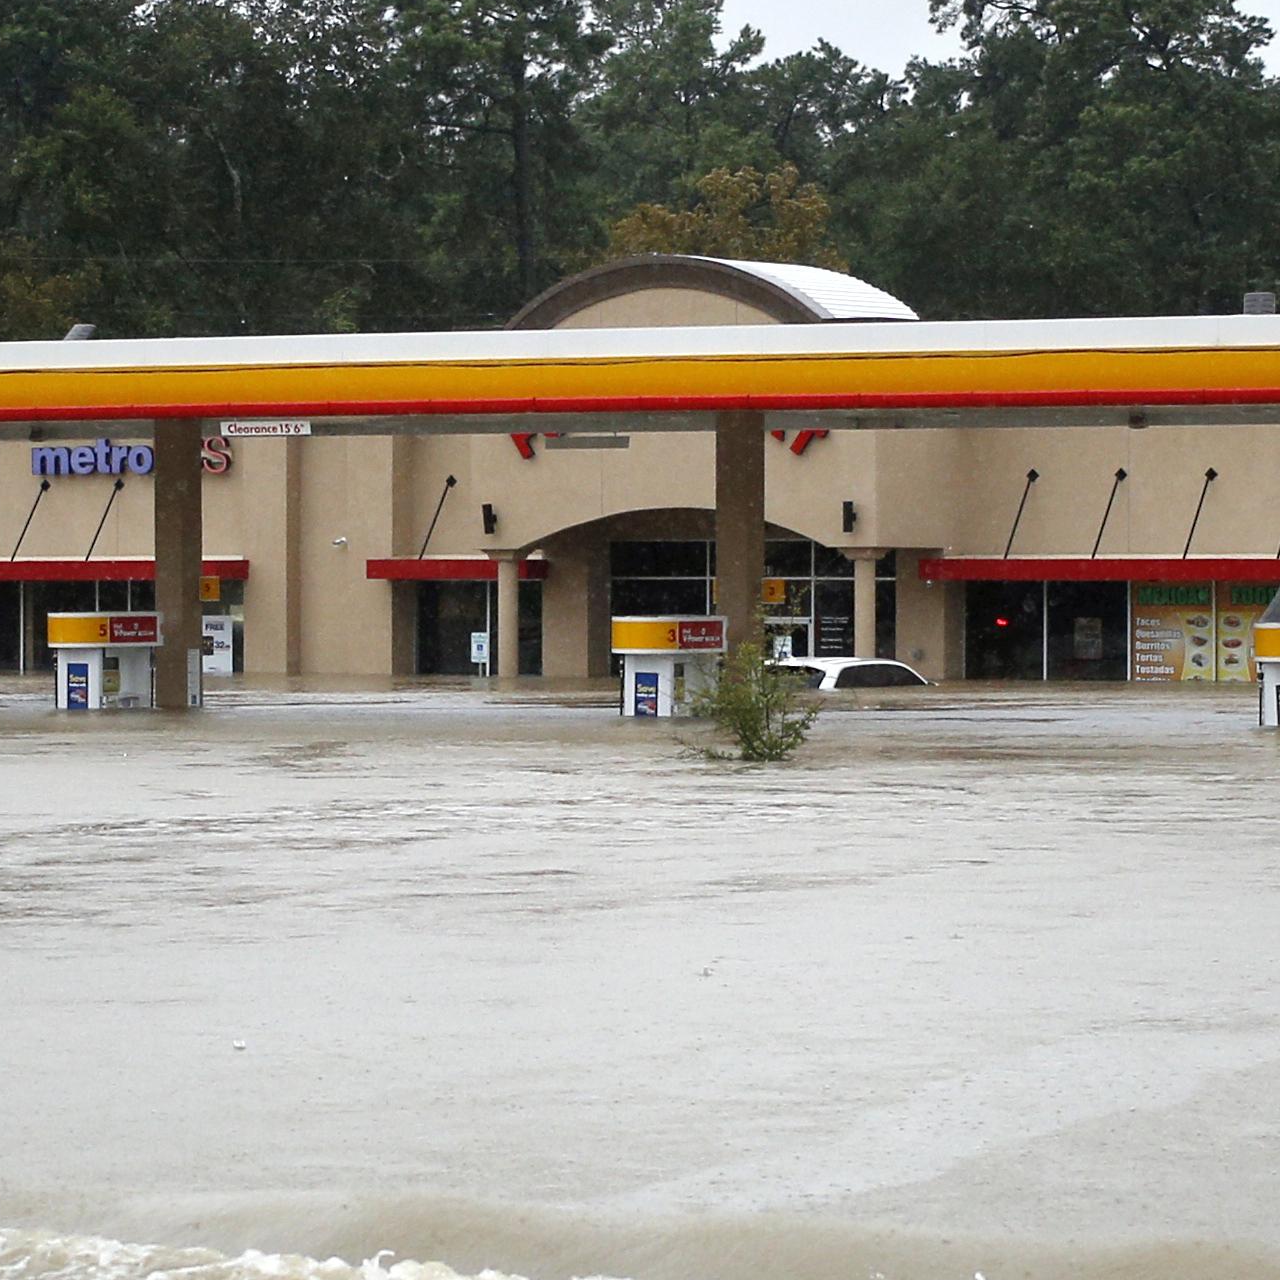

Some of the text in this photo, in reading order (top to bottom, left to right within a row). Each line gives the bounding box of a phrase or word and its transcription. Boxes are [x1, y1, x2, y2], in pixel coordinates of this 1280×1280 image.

[227, 423, 278, 434] Clearance
[1136, 618, 1161, 626] Tacos
[99, 624, 107, 637] 5
[205, 623, 224, 631] FREE
[668, 629, 676, 643] 3
[1136, 641, 1171, 651] Burritos
[1136, 653, 1163, 662] Tortas
[1136, 665, 1175, 674] Tostadas
